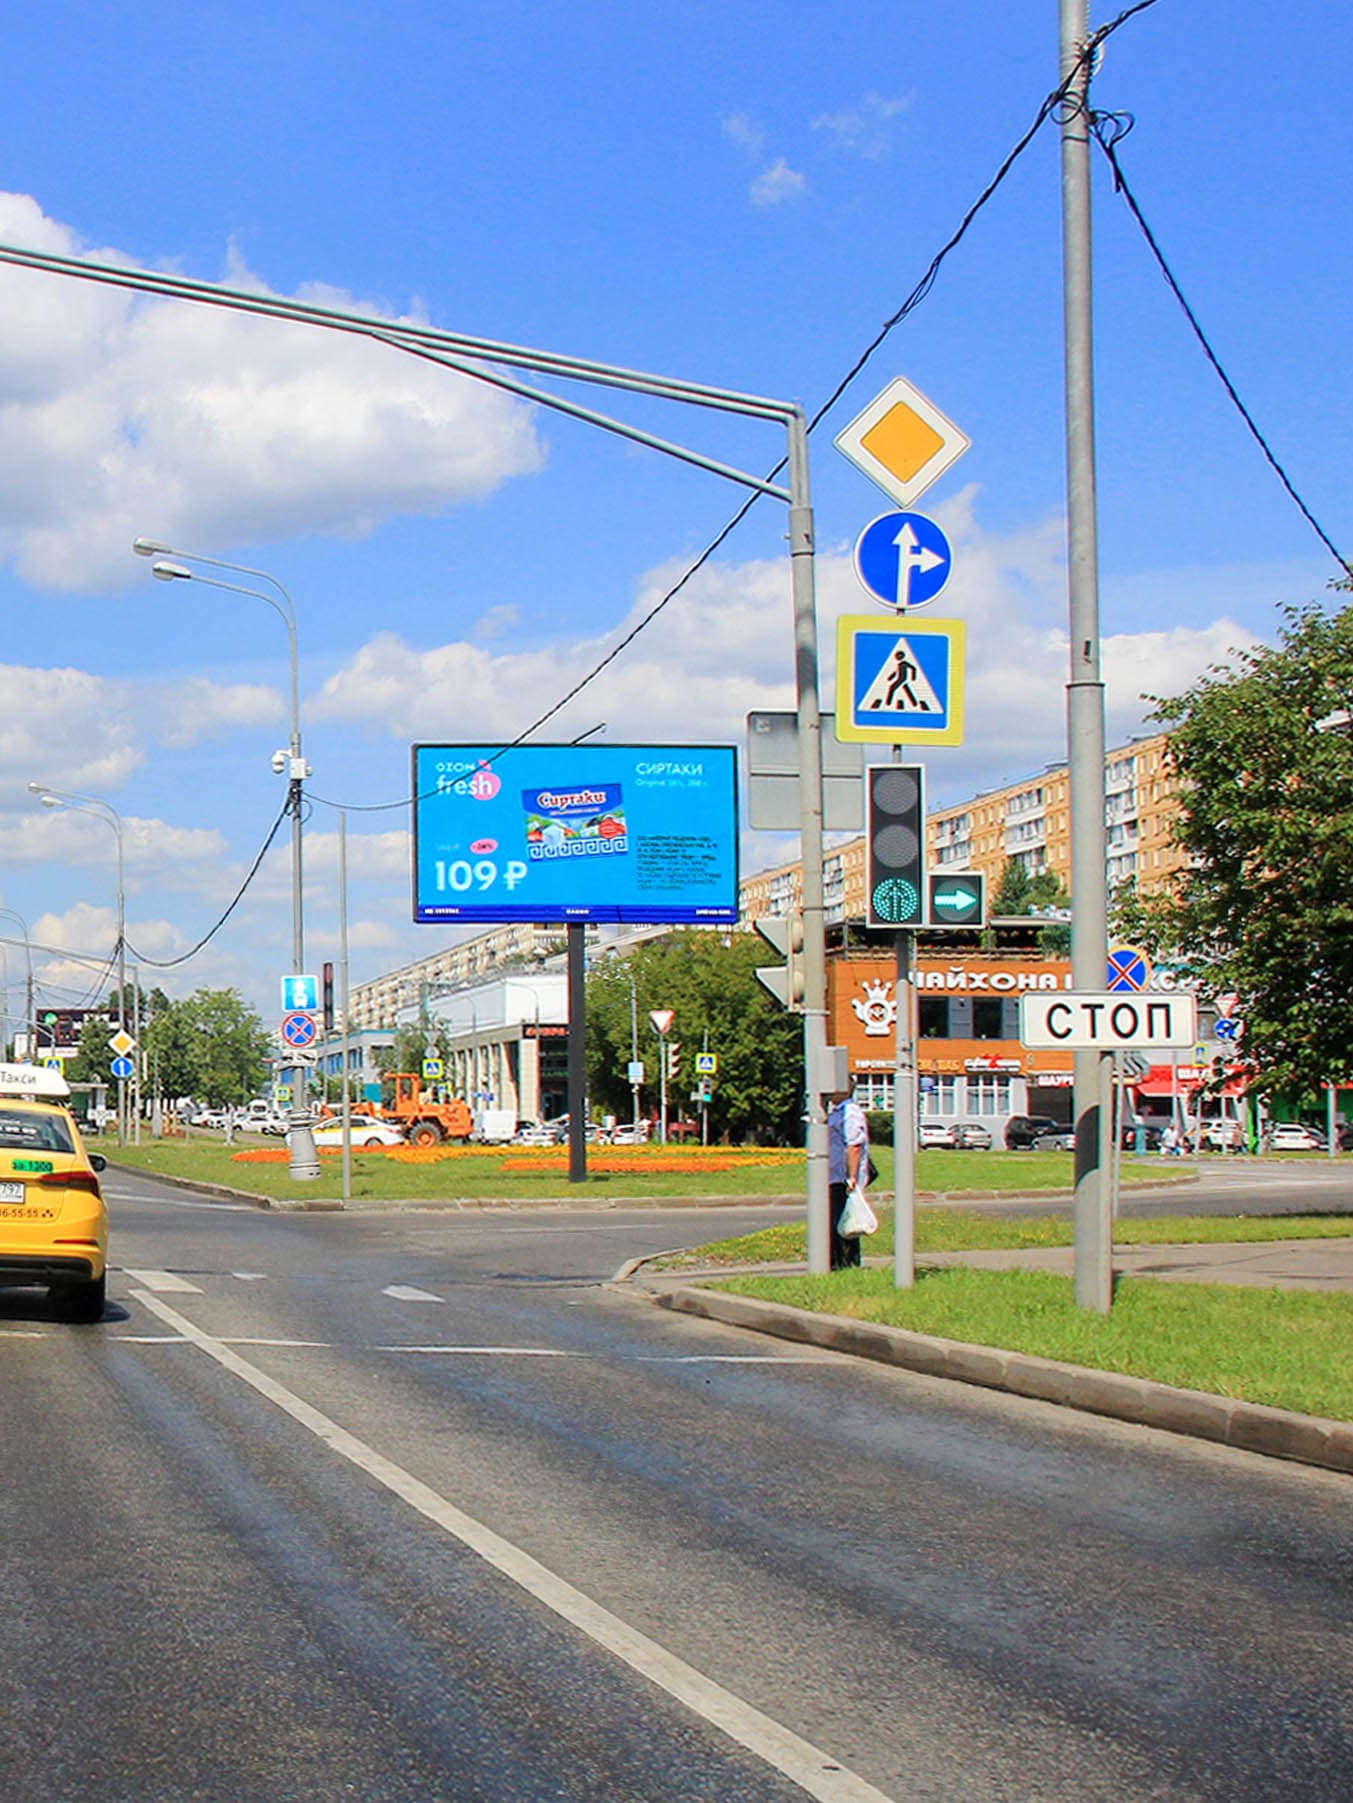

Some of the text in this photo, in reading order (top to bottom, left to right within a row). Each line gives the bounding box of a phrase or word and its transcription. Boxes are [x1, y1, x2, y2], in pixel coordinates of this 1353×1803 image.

[634, 762, 703, 776] СИРТАКИ
[436, 774, 493, 795] fresh
[537, 790, 606, 809] Сиртаки
[434, 860, 497, 891] 109
[908, 966, 1057, 991] ЧАЙХОНА
[1046, 1003, 1171, 1039] СТОП
[0, 1071, 37, 1084] Такси
